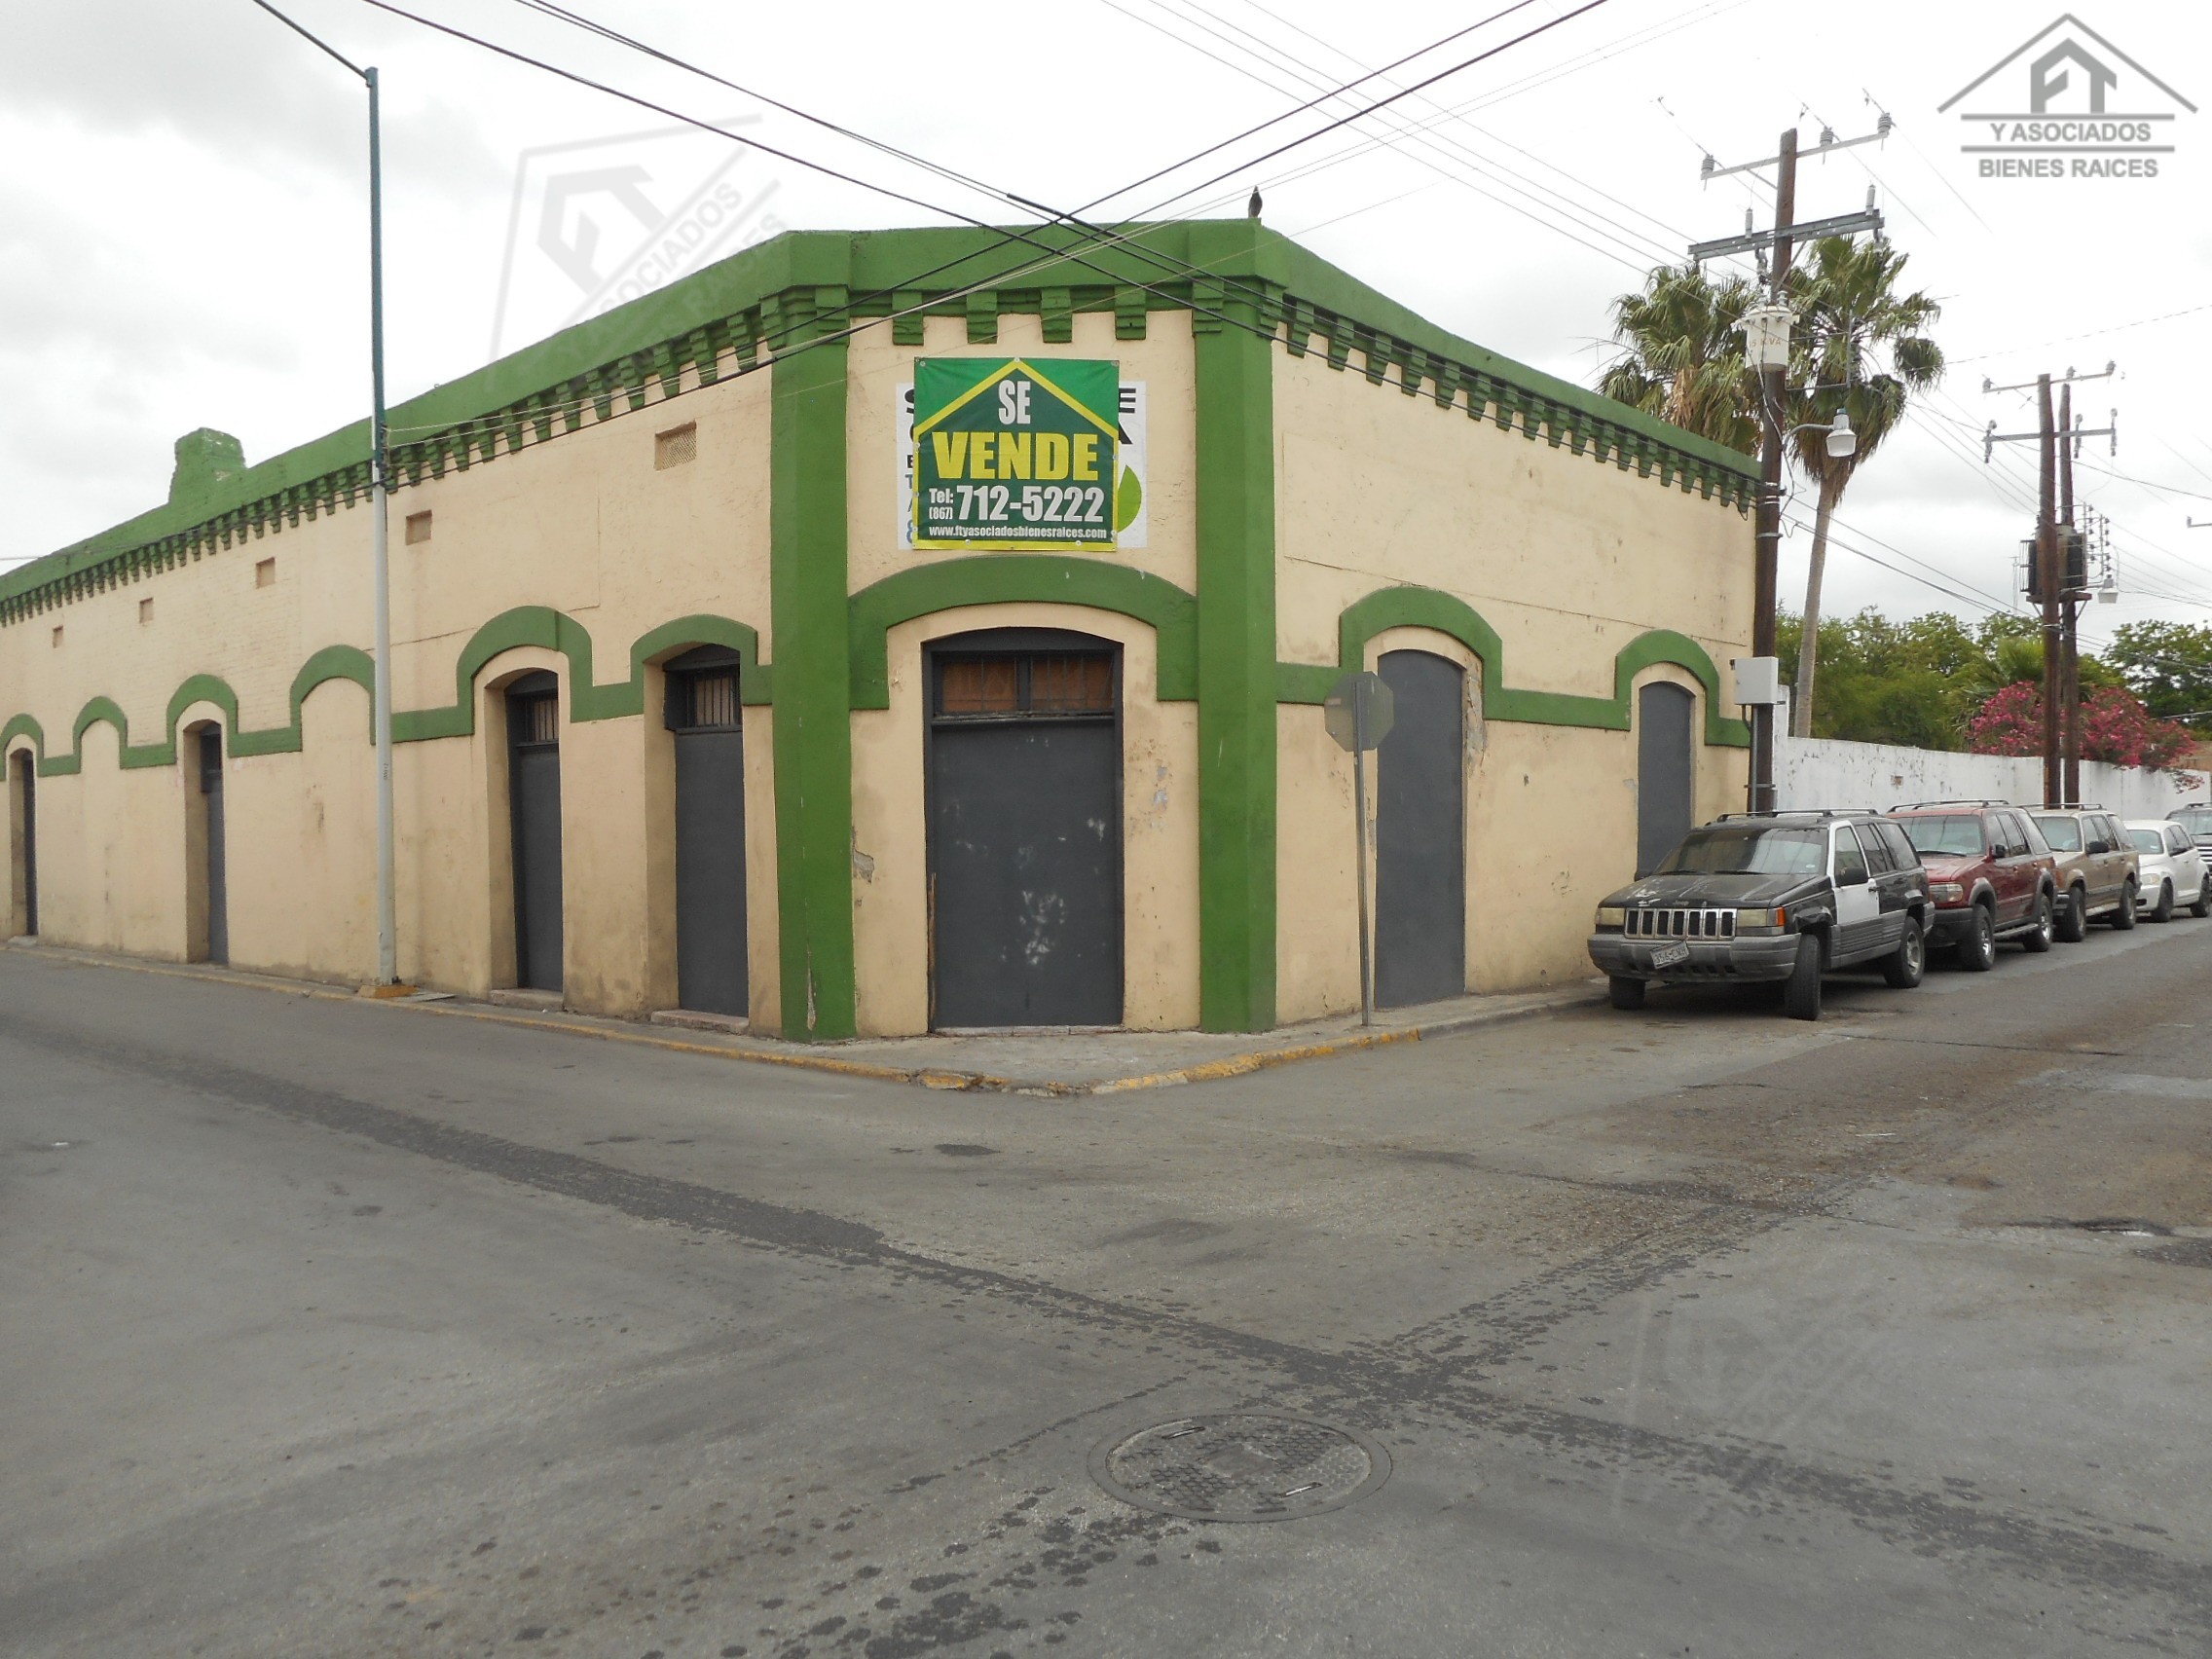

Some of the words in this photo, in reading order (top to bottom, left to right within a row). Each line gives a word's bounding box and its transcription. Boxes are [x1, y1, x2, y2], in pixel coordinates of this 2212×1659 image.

[998, 380, 1031, 424] SE
[932, 431, 1098, 481] VENDE
[929, 488, 954, 504] Tel:
[956, 485, 1105, 523] 712-5222
[929, 506, 953, 520] (867)
[929, 525, 1107, 539] www.ftyasociadosbienesraices.com
